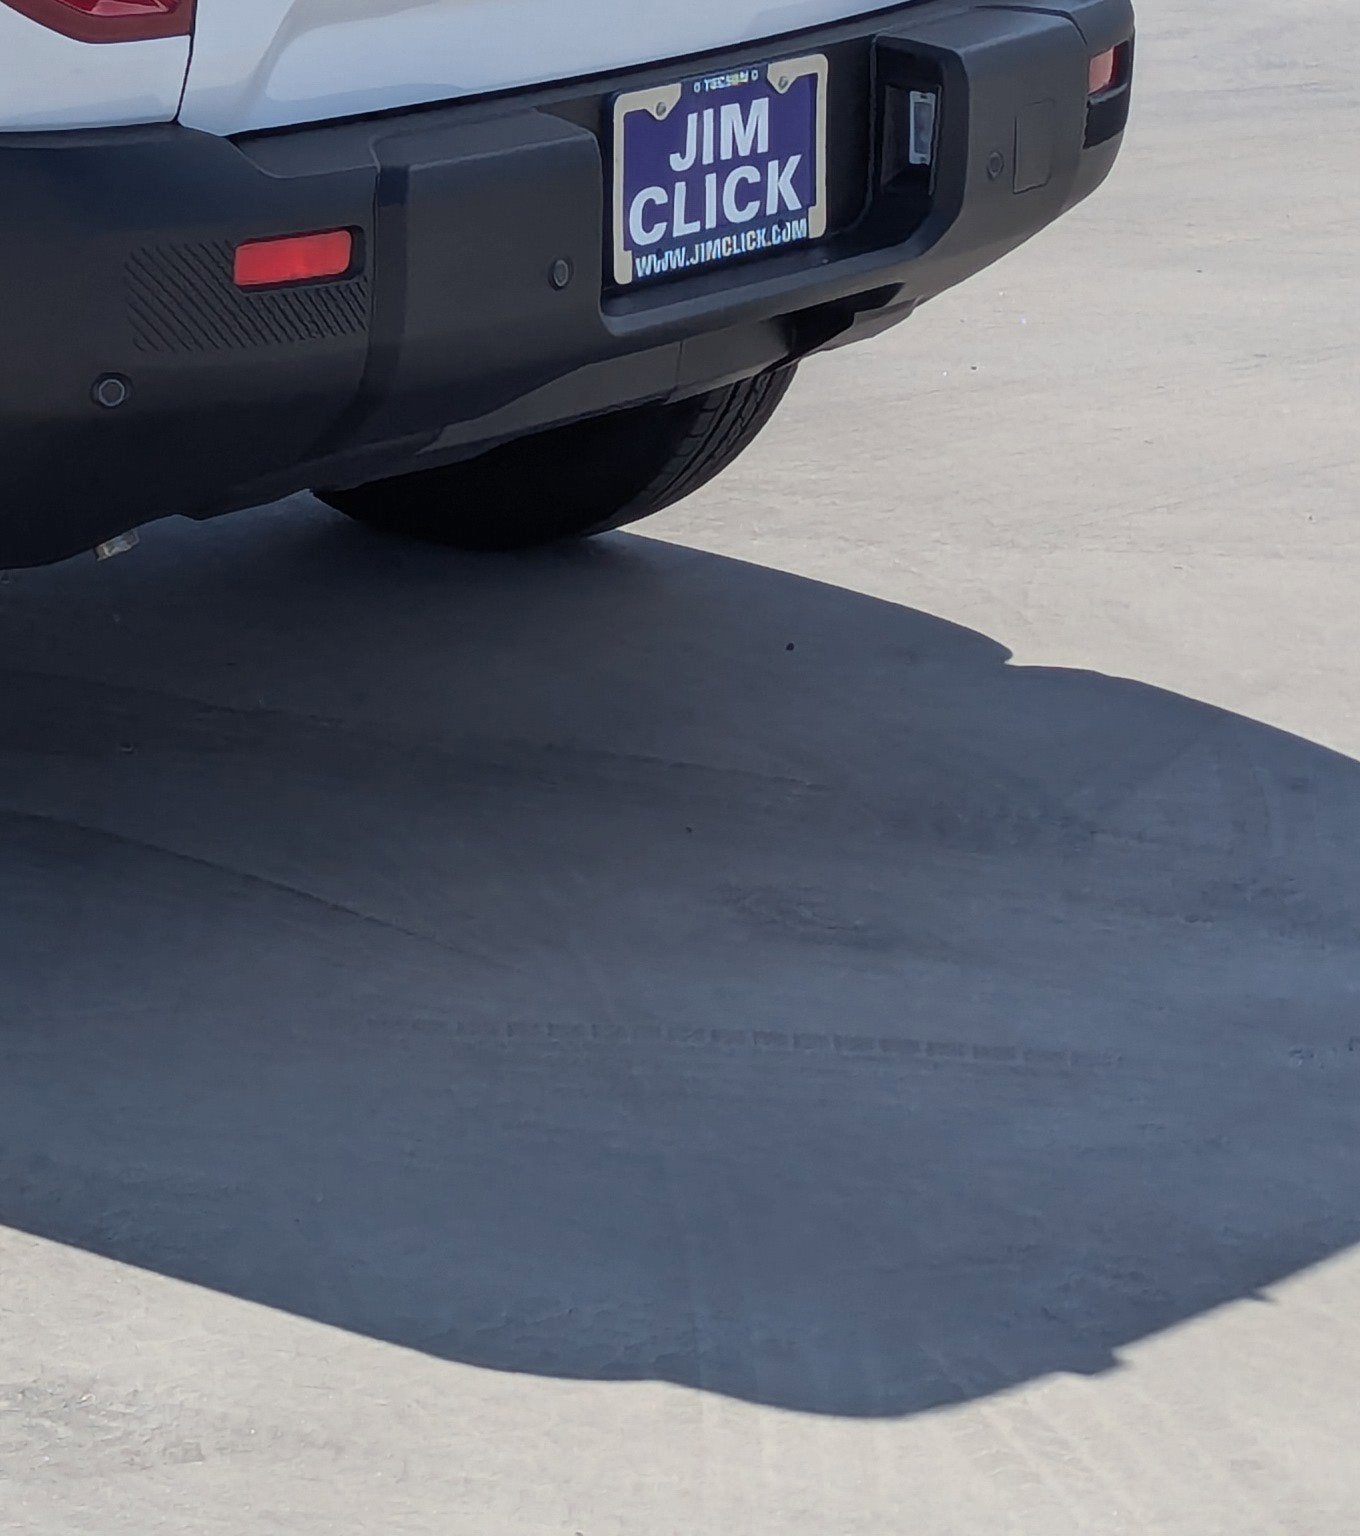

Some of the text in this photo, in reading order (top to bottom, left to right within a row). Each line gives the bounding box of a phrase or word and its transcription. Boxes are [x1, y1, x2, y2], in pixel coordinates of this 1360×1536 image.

[669, 97, 770, 172] JIM
[628, 154, 803, 247] CLICK
[635, 217, 808, 278] WWW.JIMCLICK.COM
